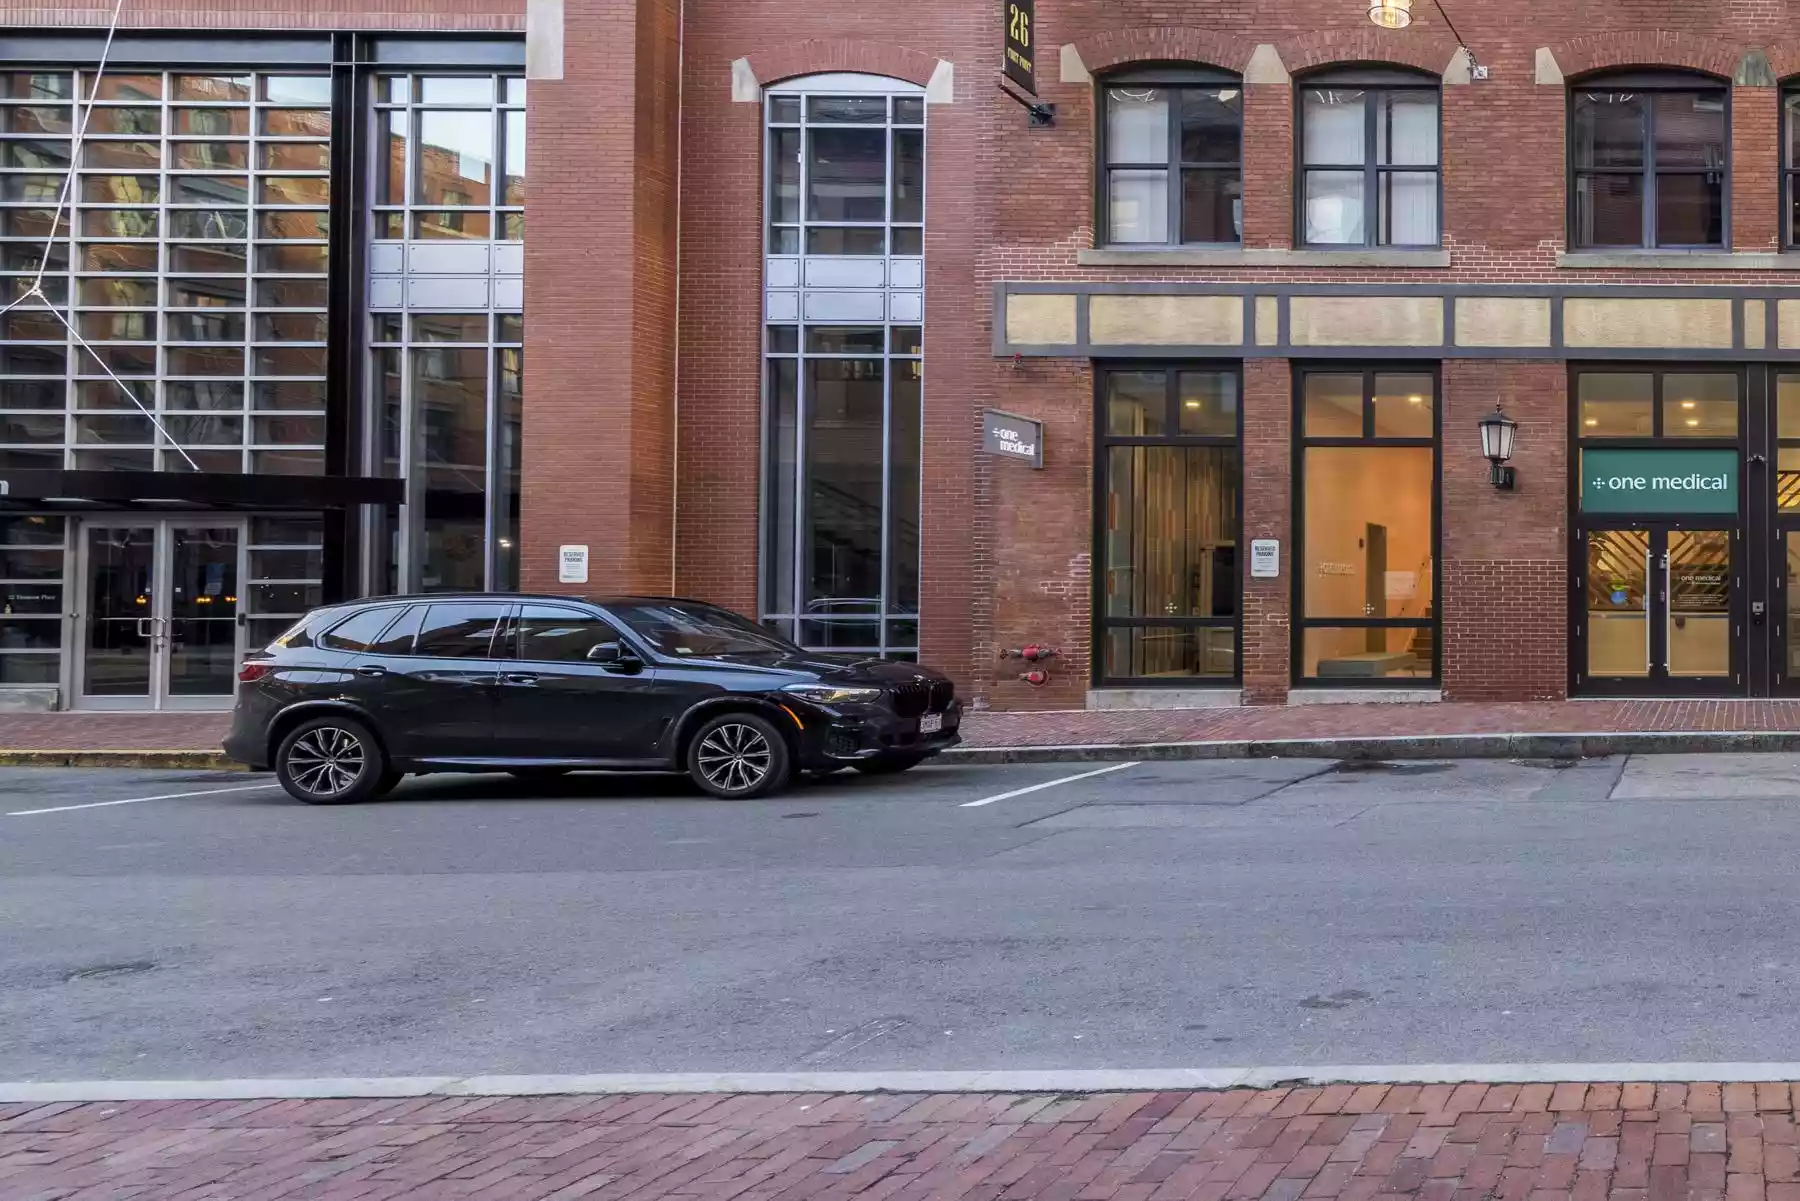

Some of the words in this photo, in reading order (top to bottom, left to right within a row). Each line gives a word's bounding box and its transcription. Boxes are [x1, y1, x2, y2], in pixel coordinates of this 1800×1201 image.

[1010, 3, 1029, 47] 26
[1000, 429, 1018, 442] one
[1000, 440, 1035, 456] medical
[1608, 476, 1646, 490] one
[1652, 473, 1728, 490] medical
